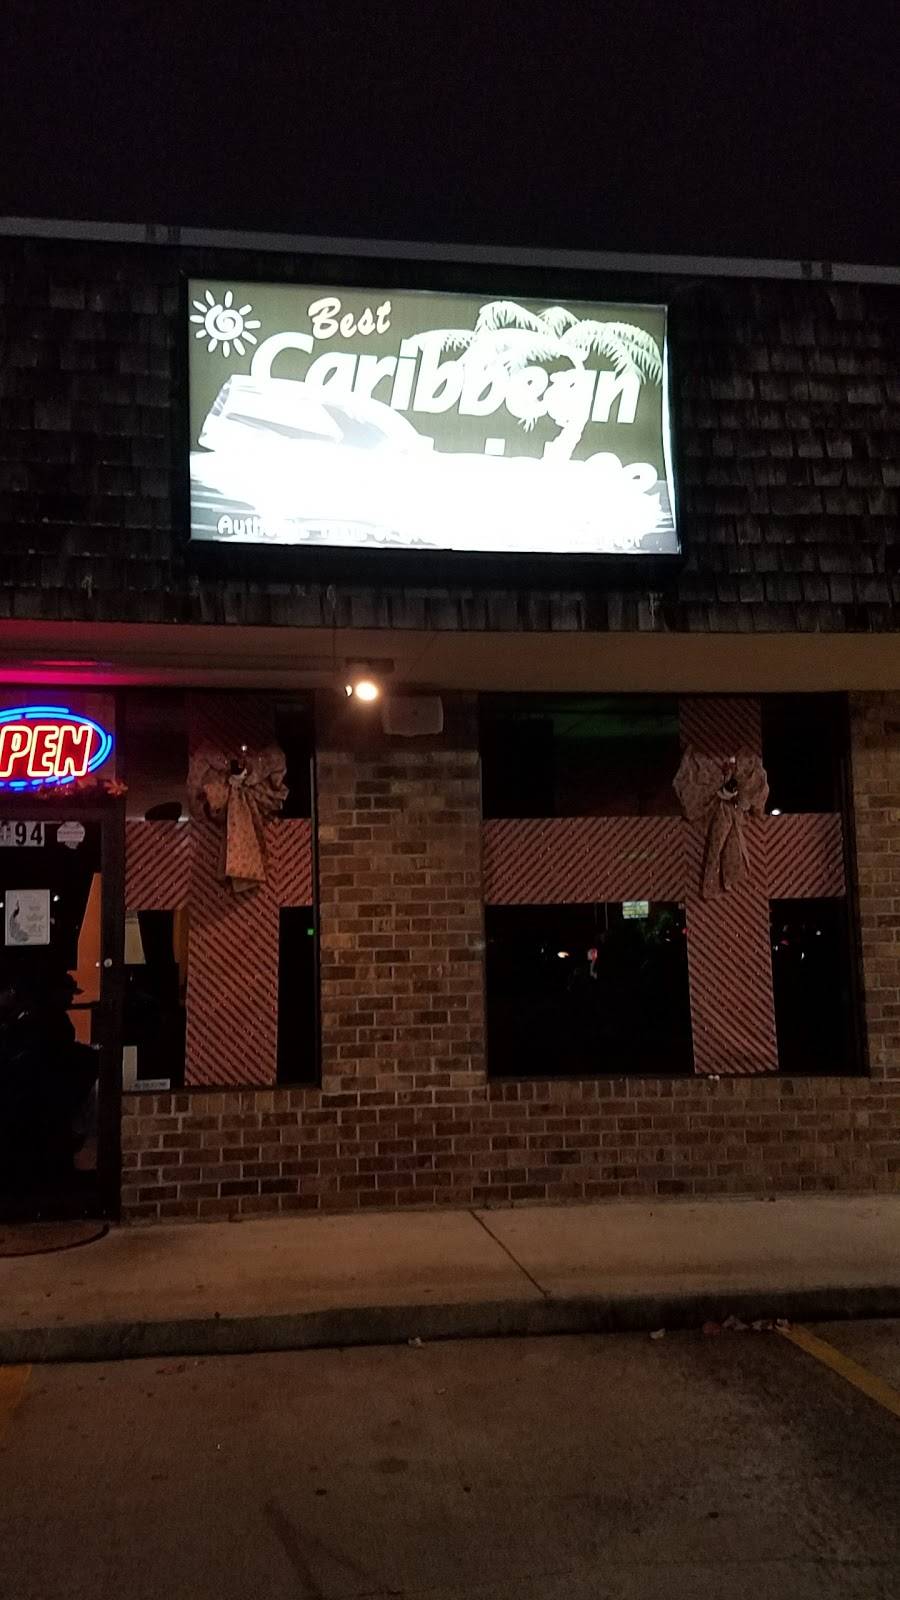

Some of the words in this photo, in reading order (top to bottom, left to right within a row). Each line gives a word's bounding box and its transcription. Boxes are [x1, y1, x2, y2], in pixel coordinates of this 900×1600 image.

[308, 297, 392, 340] Best
[250, 331, 642, 425] Caribbean
[0, 725, 93, 777] PEN
